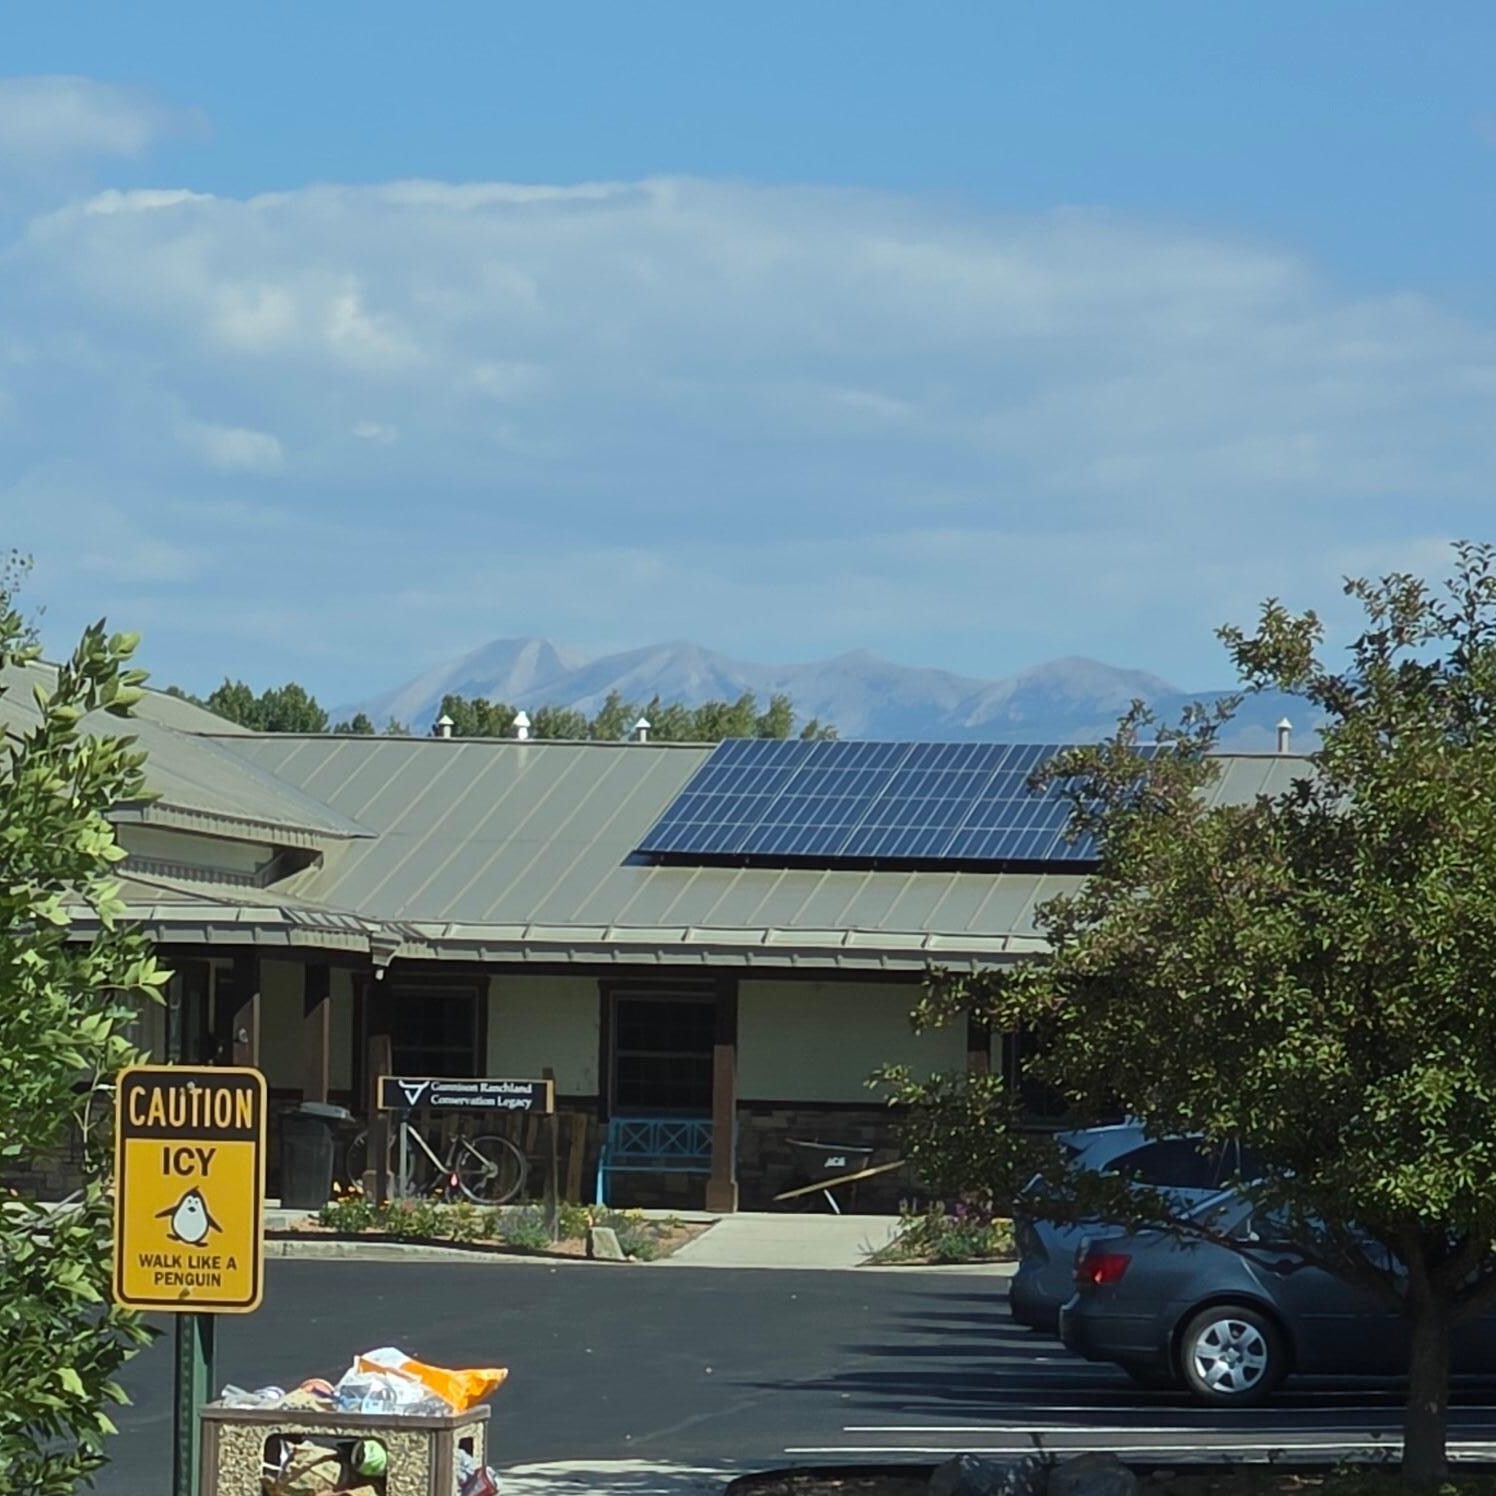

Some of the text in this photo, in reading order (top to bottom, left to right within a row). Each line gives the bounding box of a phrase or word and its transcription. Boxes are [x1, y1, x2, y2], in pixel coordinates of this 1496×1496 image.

[129, 1086, 254, 1129] CAUTION
[497, 1096, 532, 1110] Legacy
[162, 1147, 217, 1177] ICY
[139, 1254, 238, 1271] WALK LIKE A
[154, 1272, 222, 1288] PENGUIN
